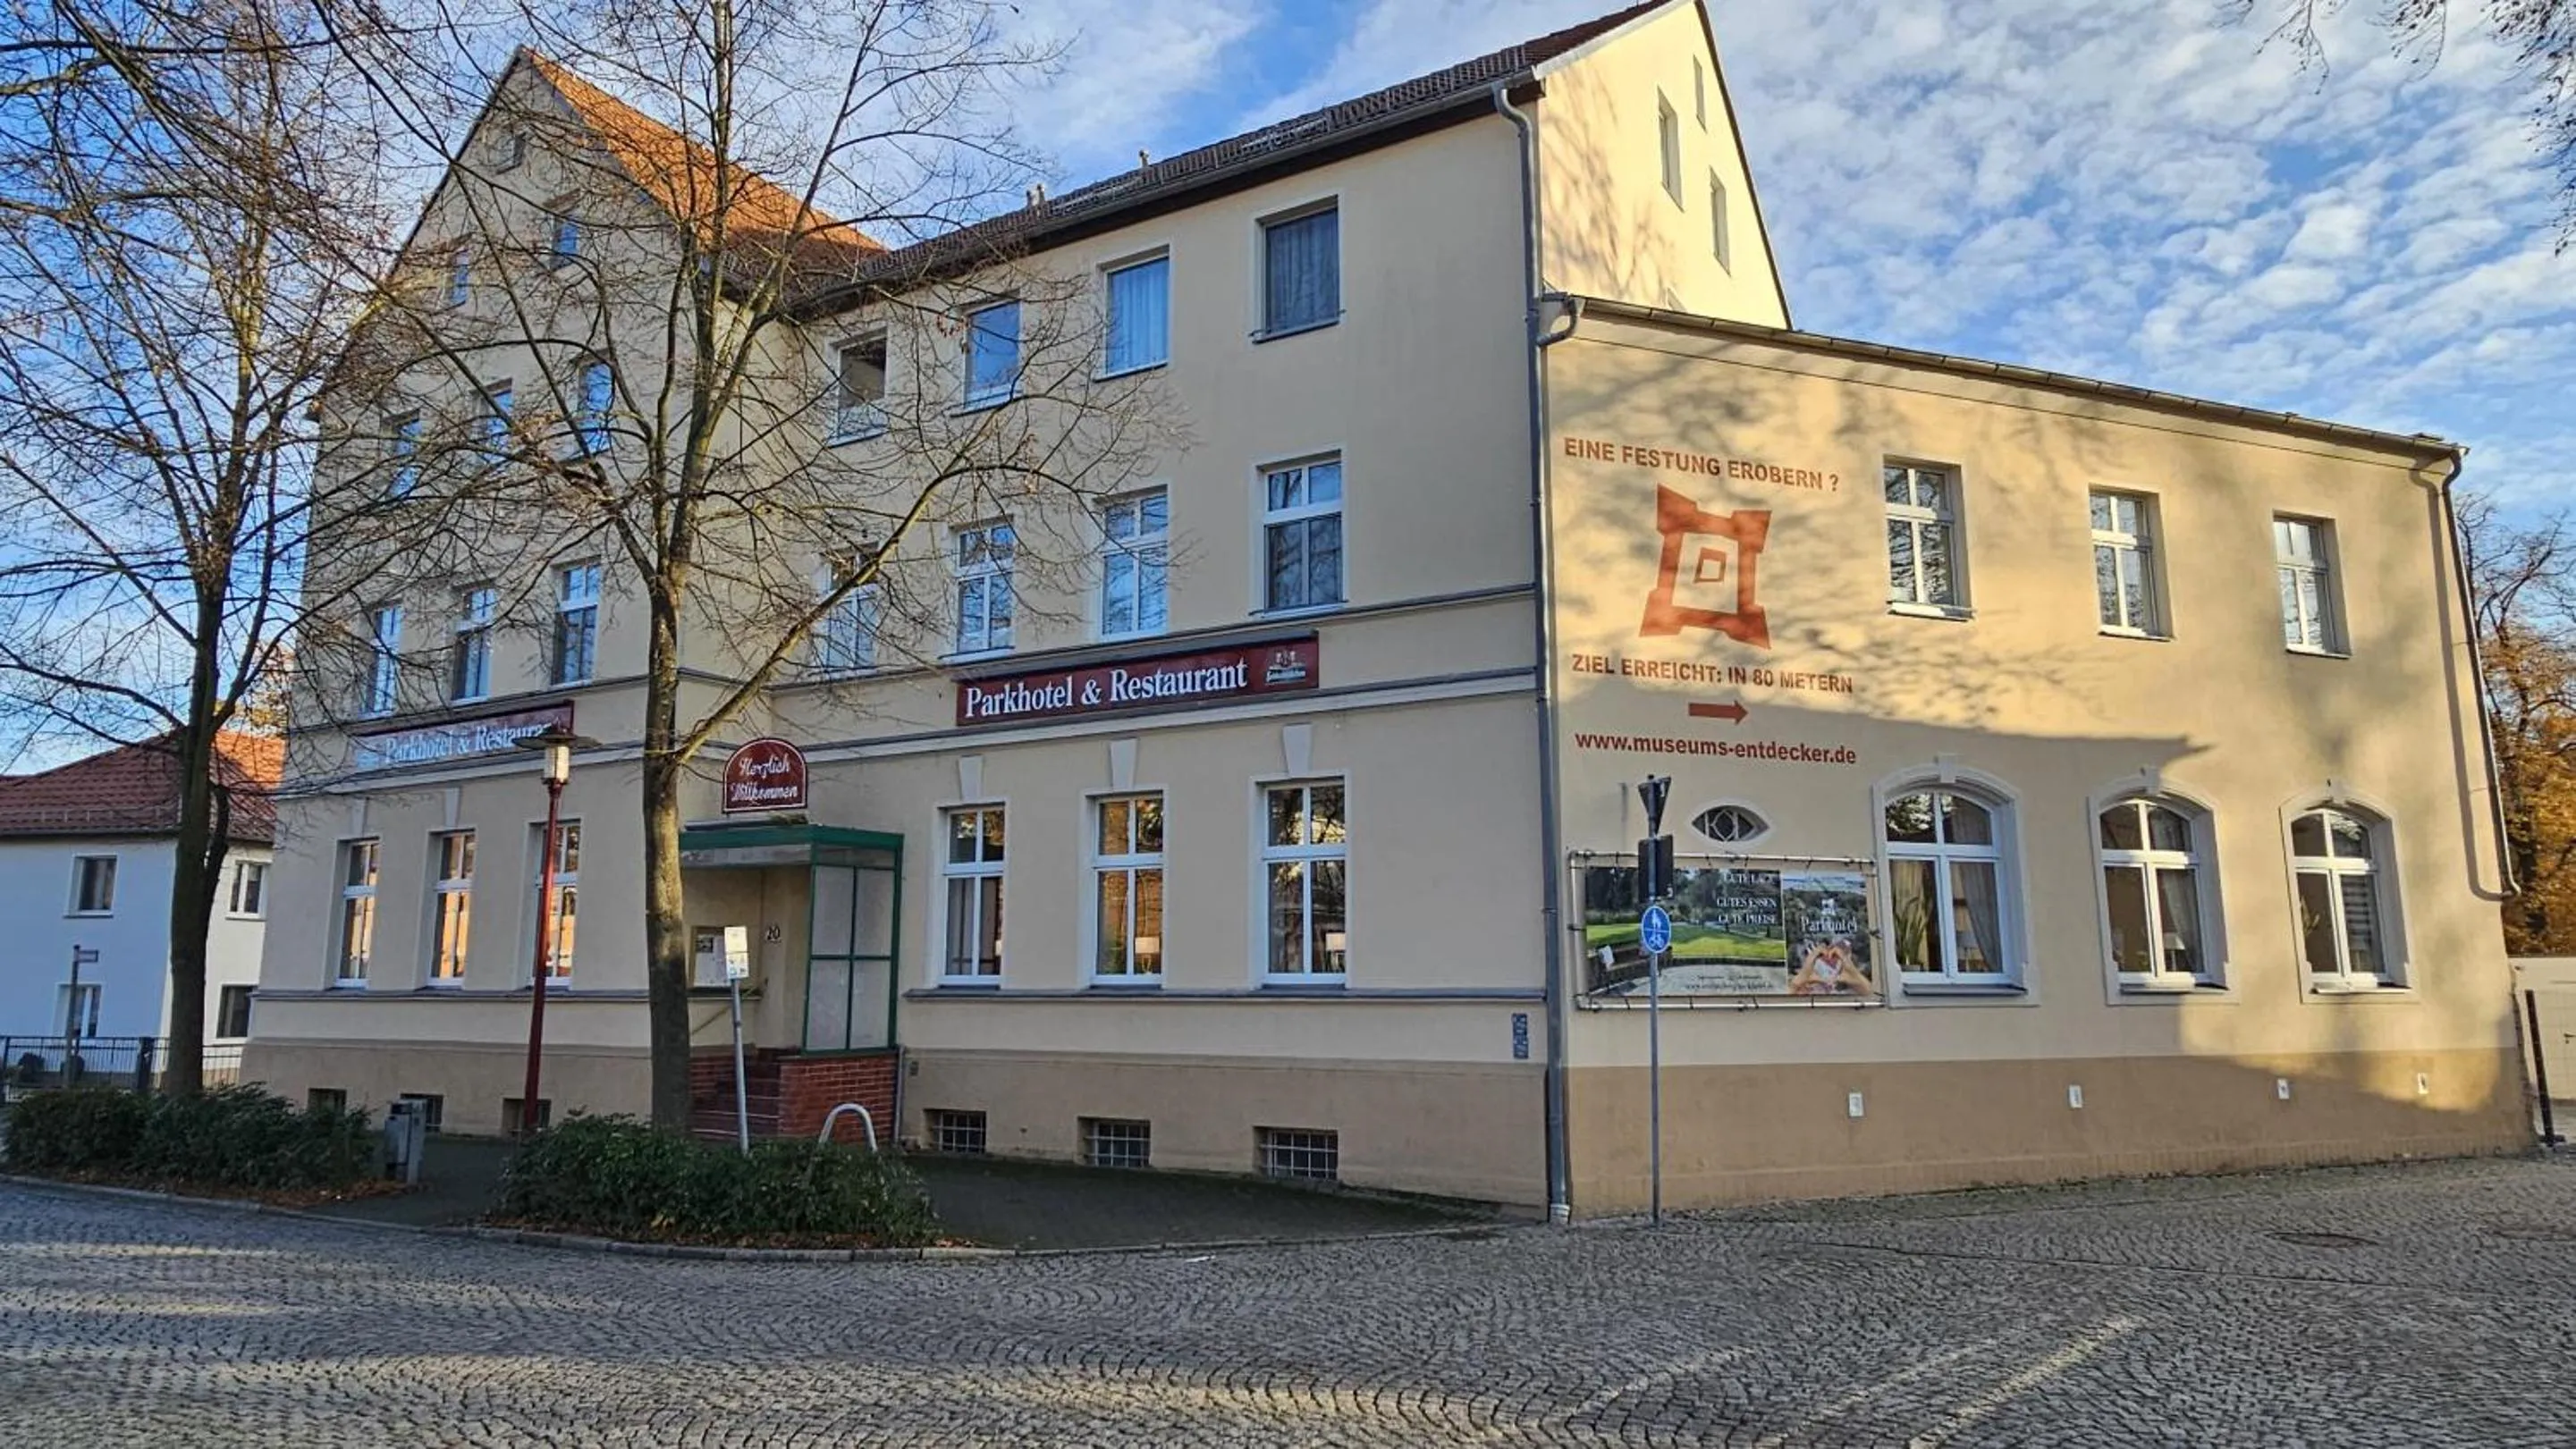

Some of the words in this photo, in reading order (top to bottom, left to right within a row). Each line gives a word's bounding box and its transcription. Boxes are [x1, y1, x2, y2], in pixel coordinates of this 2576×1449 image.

[1564, 437, 1616, 462] EINE
[1621, 445, 1721, 476] FESTUNG
[1727, 460, 1823, 490] EROBERN
[965, 676, 1074, 718] Parkhotel
[1080, 679, 1102, 705] &
[1110, 658, 1248, 703] Restaurant
[1571, 653, 1615, 675] ZIEL
[1621, 660, 1722, 684] ERREICHT:
[1727, 666, 1747, 685] IN
[1753, 669, 1774, 687] 80
[1779, 670, 1854, 694] METERN
[385, 730, 453, 763] Parkhotel
[1575, 732, 1857, 764] www.museums-entdecker.de
[739, 754, 790, 779] Herzlich
[766, 925, 781, 940] 20
